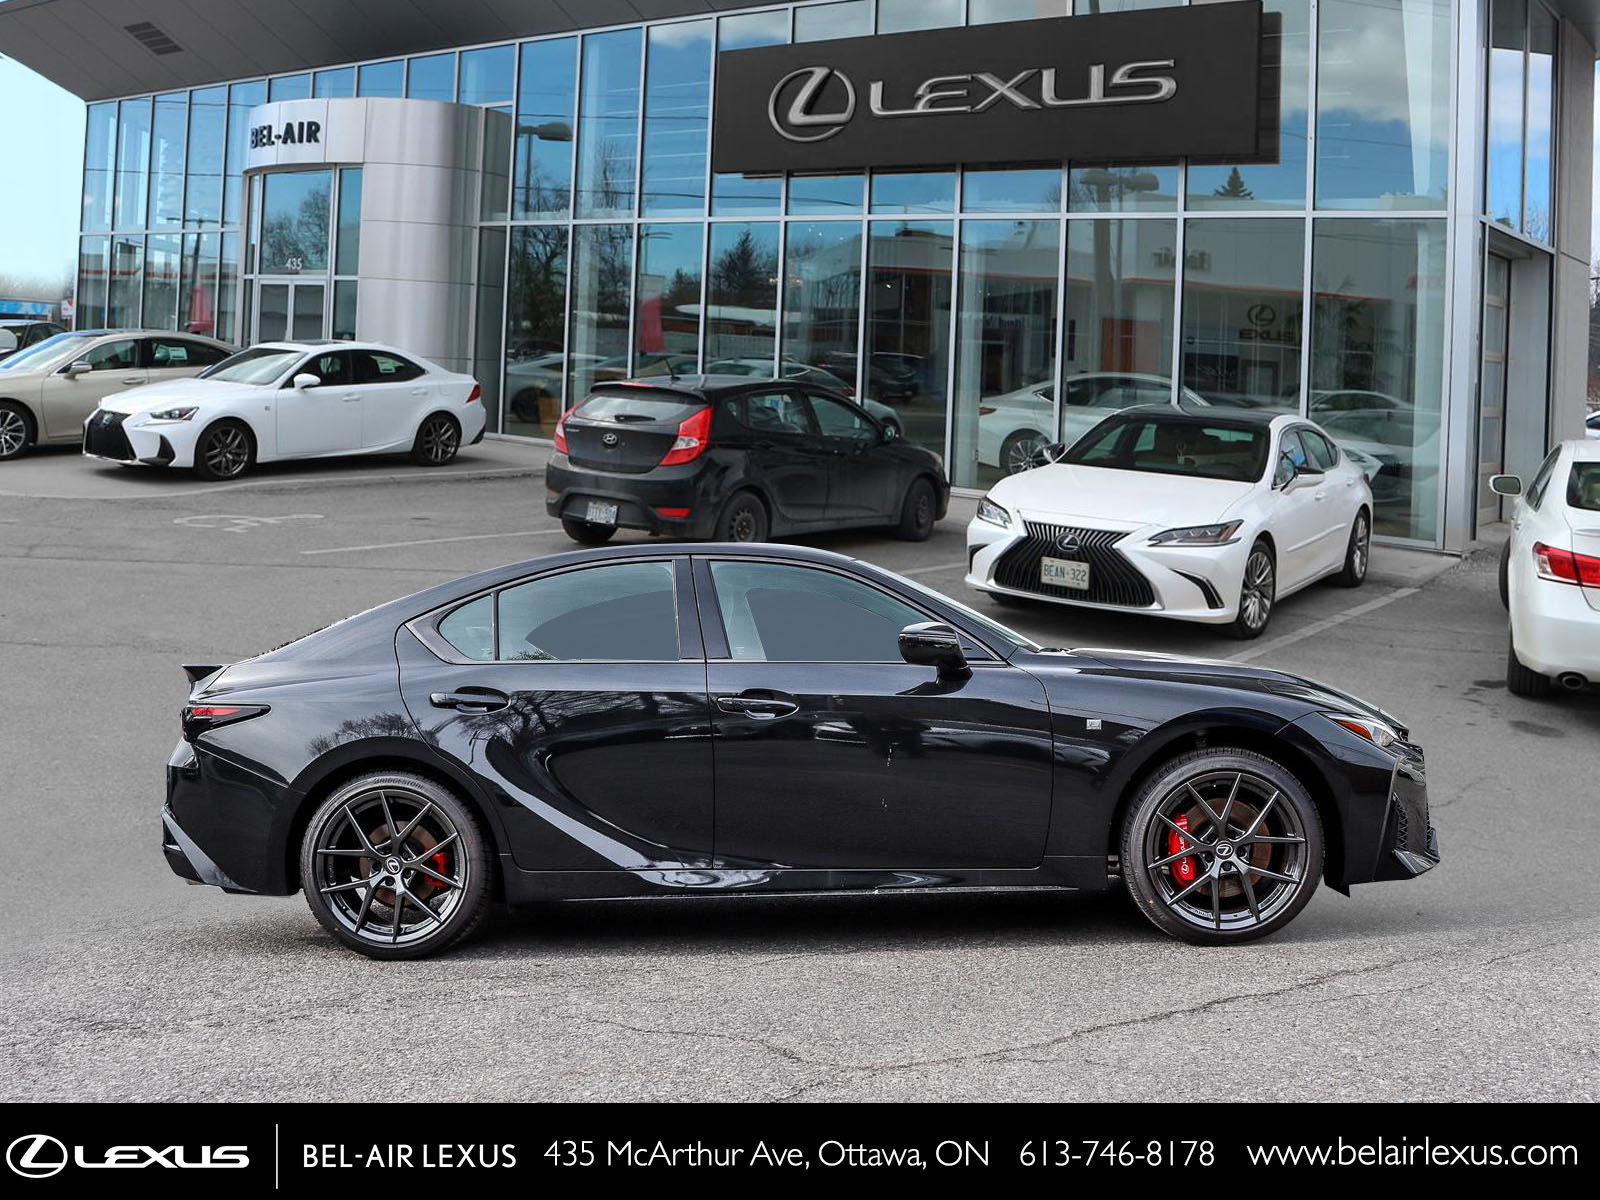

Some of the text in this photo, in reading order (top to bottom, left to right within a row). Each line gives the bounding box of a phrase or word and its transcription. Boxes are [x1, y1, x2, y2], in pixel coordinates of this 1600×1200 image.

[868, 58, 1178, 118] LEXUS
[250, 120, 321, 149] BEL-AIR
[285, 257, 303, 270] 435
